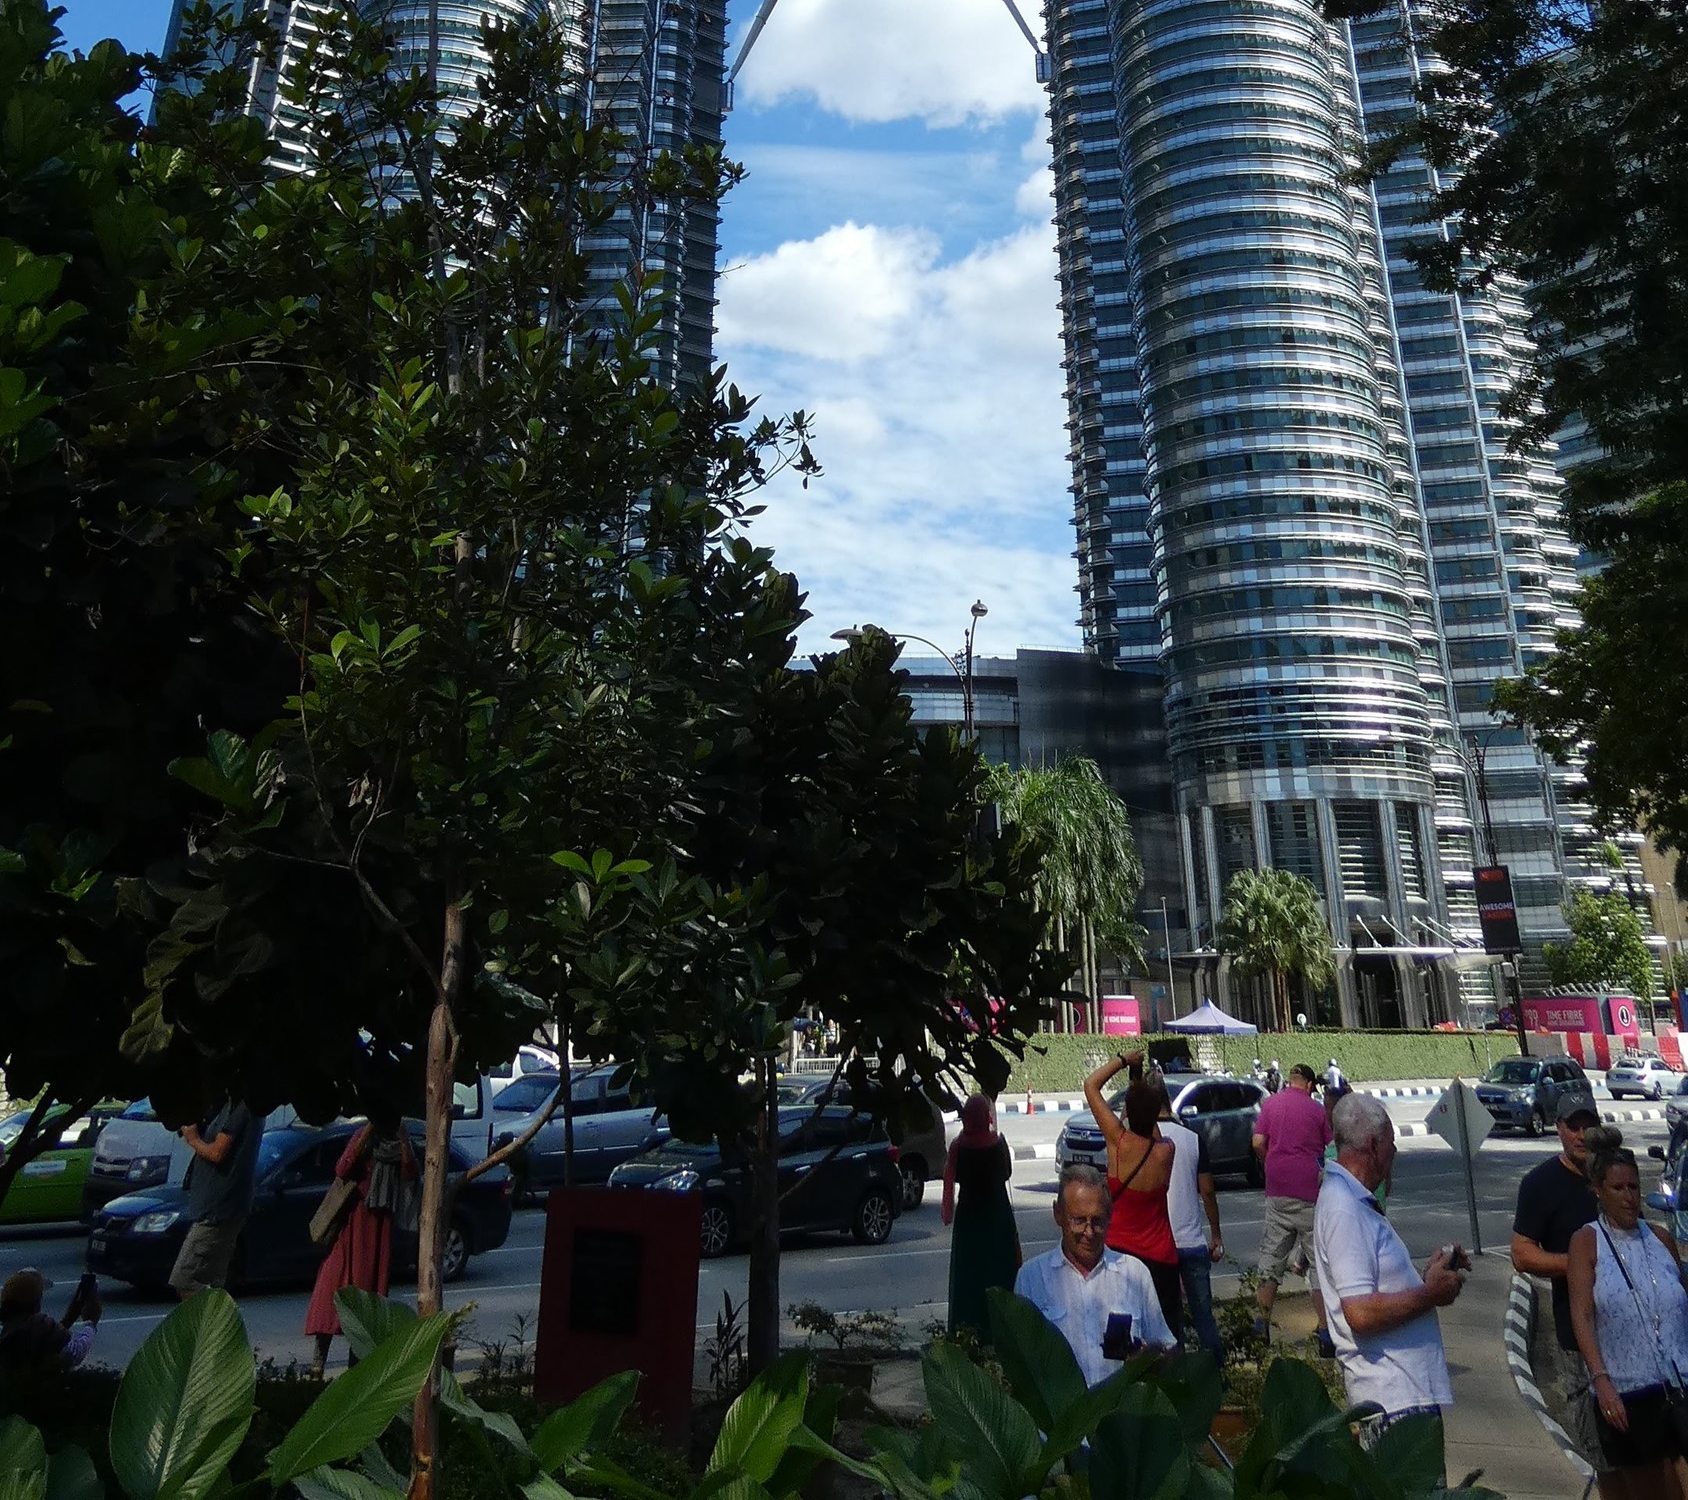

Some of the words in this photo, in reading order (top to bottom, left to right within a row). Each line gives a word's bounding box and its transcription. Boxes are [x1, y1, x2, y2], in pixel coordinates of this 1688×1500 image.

[1480, 902, 1513, 911] AWESOME
[1546, 1010, 1562, 1020] TIME
[1563, 1009, 1583, 1020] FIBRE
